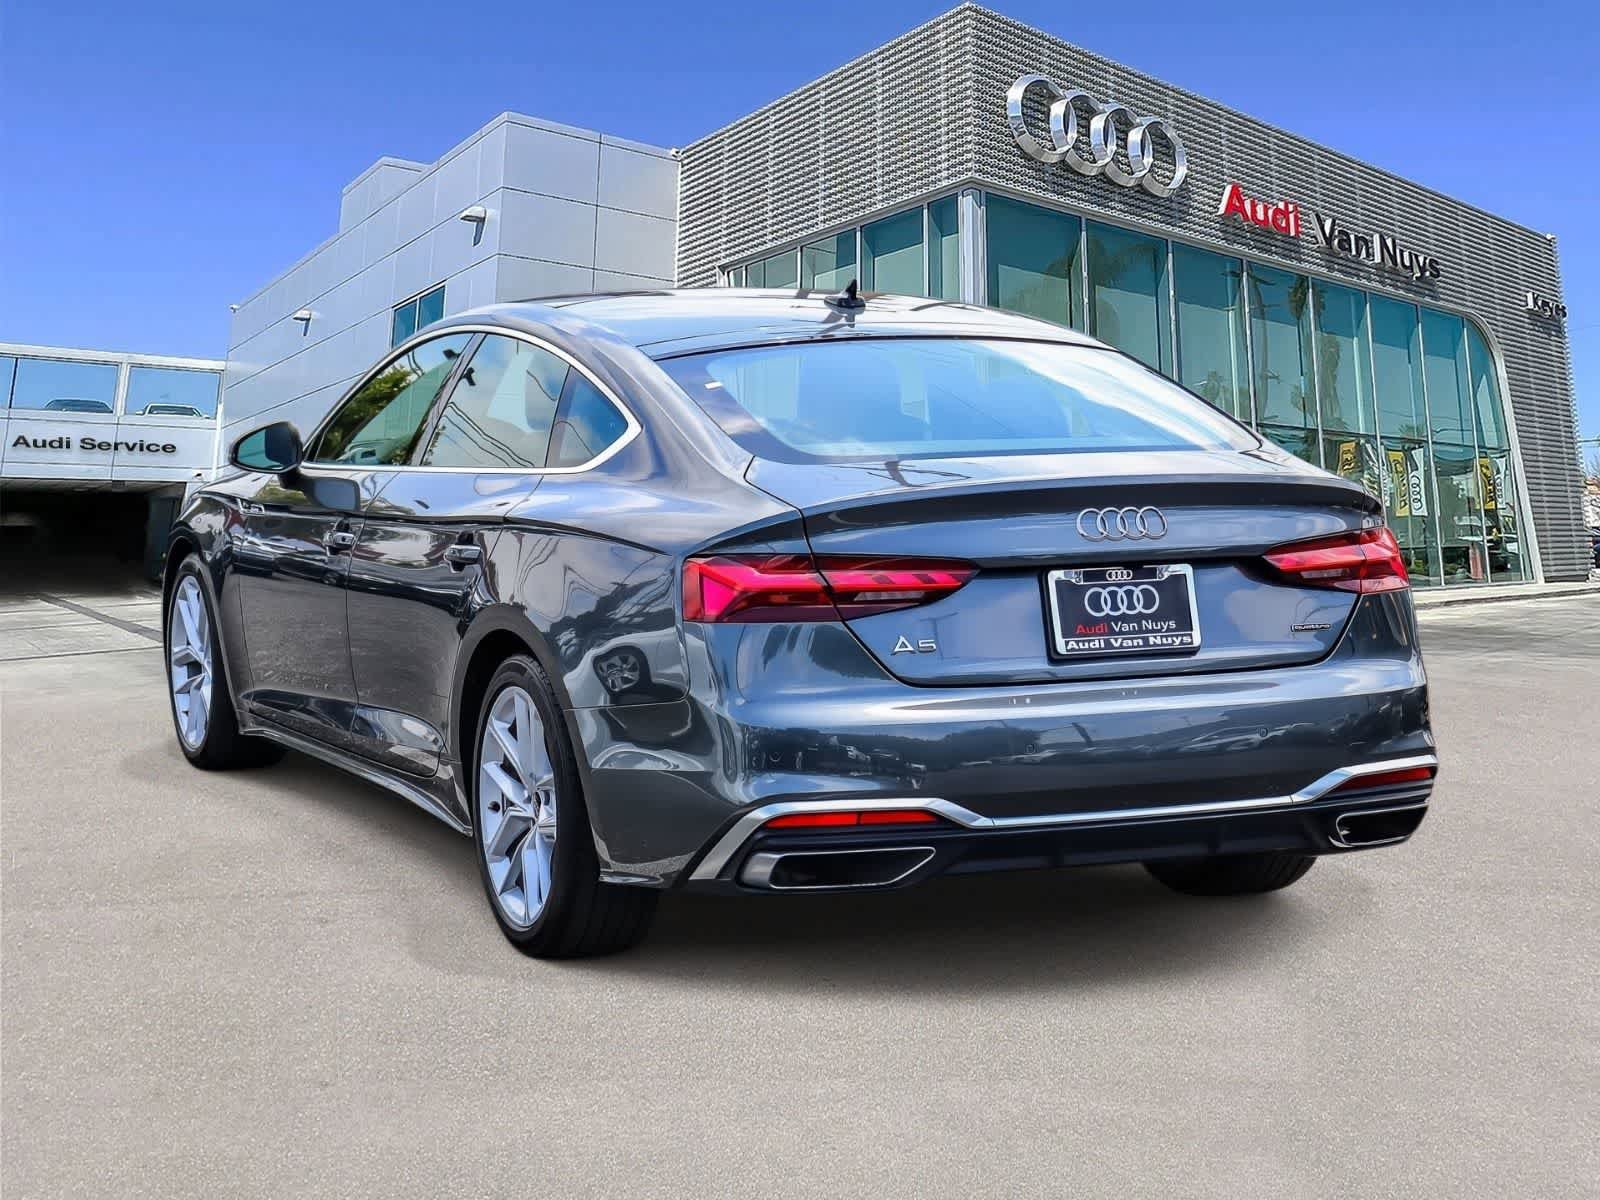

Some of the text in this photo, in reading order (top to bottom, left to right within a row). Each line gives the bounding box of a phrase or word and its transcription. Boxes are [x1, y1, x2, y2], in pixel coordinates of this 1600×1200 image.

[1220, 182, 1441, 280] Audi Van Nuys
[12, 435, 177, 454] Audi Service
[1075, 618, 1177, 635] Audi Van Nuys
[891, 635, 937, 653] A5
[1066, 634, 1192, 650] Audi Van Nuys
